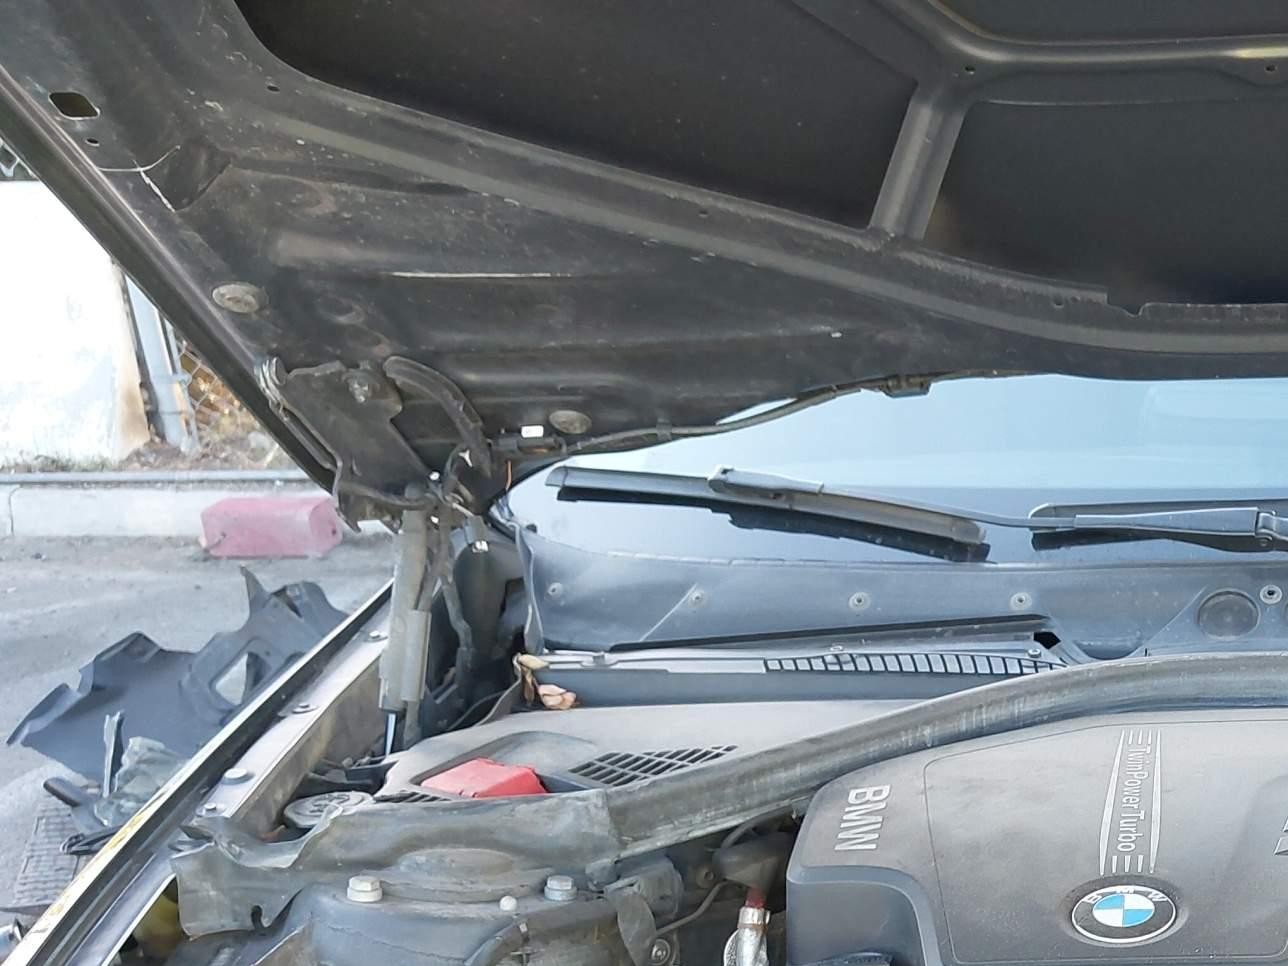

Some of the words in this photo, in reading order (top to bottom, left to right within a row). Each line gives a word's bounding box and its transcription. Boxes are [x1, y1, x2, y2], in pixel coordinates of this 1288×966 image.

[1121, 744, 1151, 809] TwinPower
[834, 783, 891, 850] BMW
[1116, 809, 1145, 852] Turbo
[1083, 886, 1169, 904] BMW
